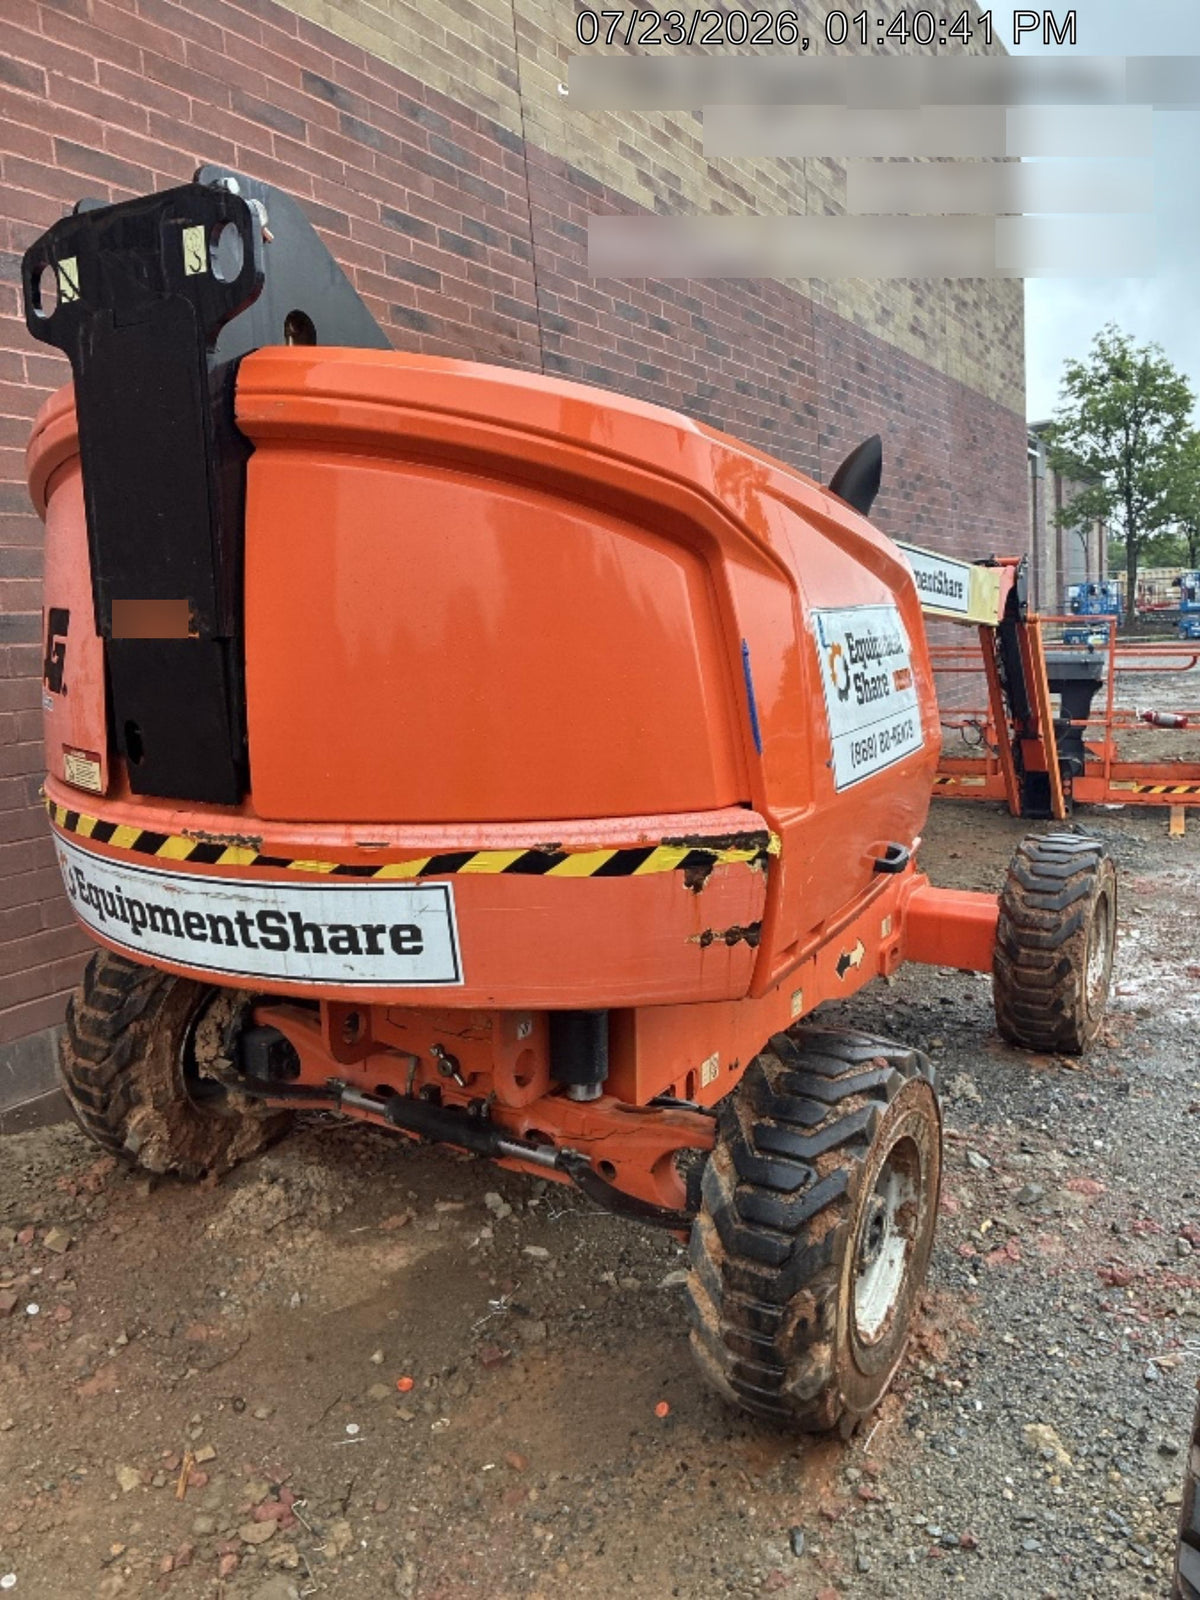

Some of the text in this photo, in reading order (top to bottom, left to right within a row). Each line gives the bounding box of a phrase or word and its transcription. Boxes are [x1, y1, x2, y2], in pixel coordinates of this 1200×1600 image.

[913, 569, 963, 599] mentShare
[853, 672, 890, 705] Share
[73, 865, 424, 956] EquipmentShare
